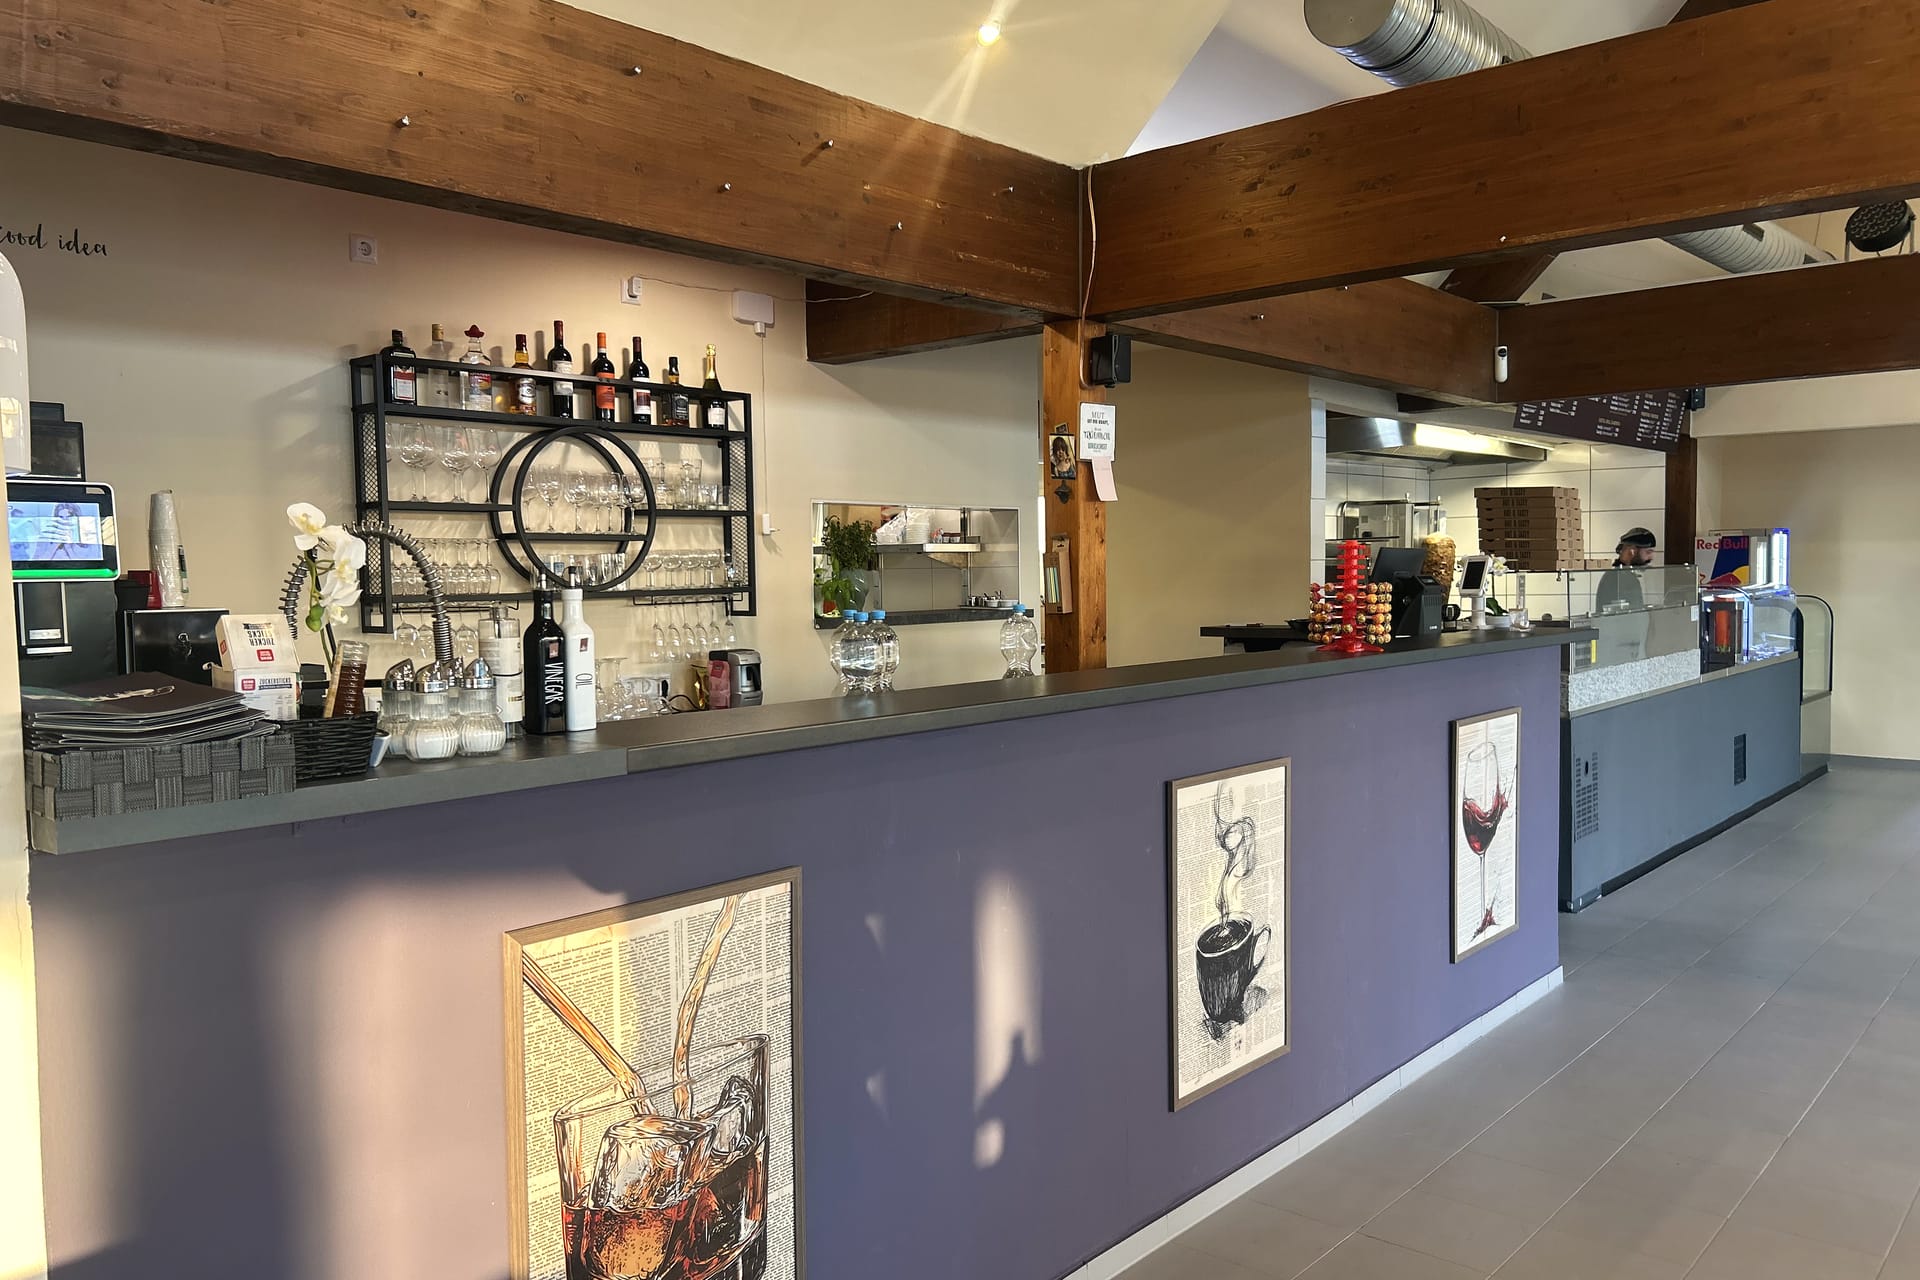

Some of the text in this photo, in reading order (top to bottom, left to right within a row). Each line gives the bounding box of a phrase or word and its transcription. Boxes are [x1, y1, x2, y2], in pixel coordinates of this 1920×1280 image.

[0, 224, 107, 256] ood idea
[1696, 537, 1748, 549] Red Bull
[249, 638, 275, 646] ZUCKER
[544, 662, 565, 705] VINEGAR
[575, 672, 593, 690] OIL
